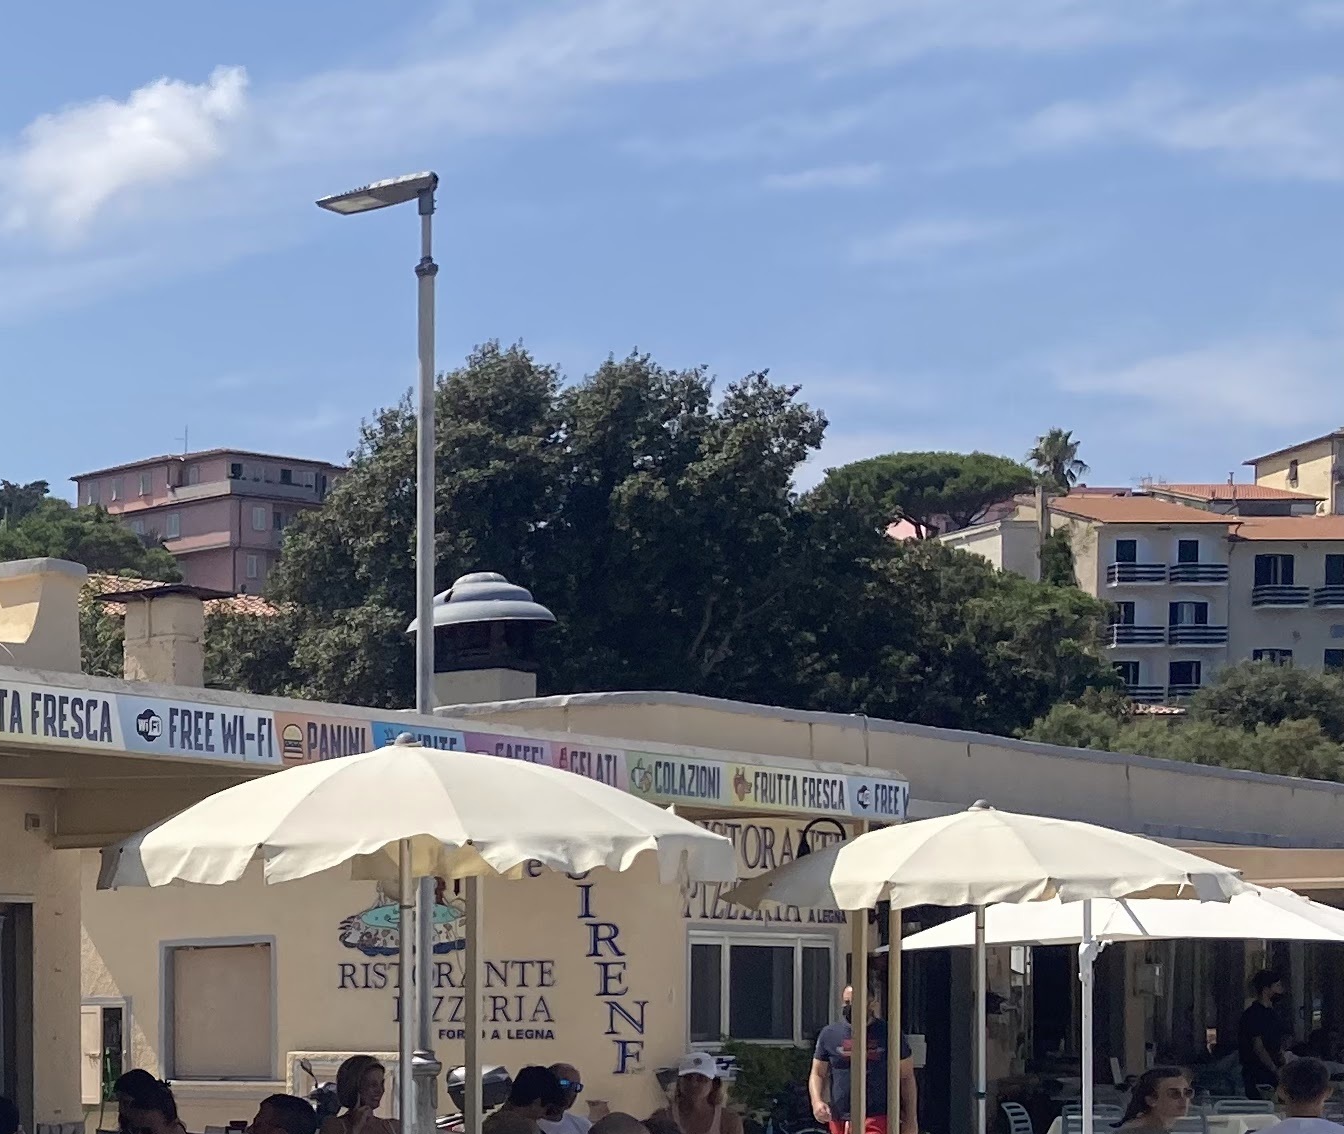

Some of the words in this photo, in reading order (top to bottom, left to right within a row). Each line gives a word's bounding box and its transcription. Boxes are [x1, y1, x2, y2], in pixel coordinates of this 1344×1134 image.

[31, 692, 113, 743] FRESCA
[169, 707, 215, 752] FREE
[221, 713, 273, 757] WI-FI
[307, 721, 366, 761] PANINI
[654, 761, 721, 800] COLAZIONI
[754, 771, 798, 807] FRUTTA
[802, 776, 846, 811] FRESCA
[874, 783, 900, 815] FREE
[337, 959, 557, 990] RISTRNTE
[438, 1029, 486, 1040] FOR
[490, 1029, 501, 1040] A
[506, 1028, 555, 1040] LEGNA
